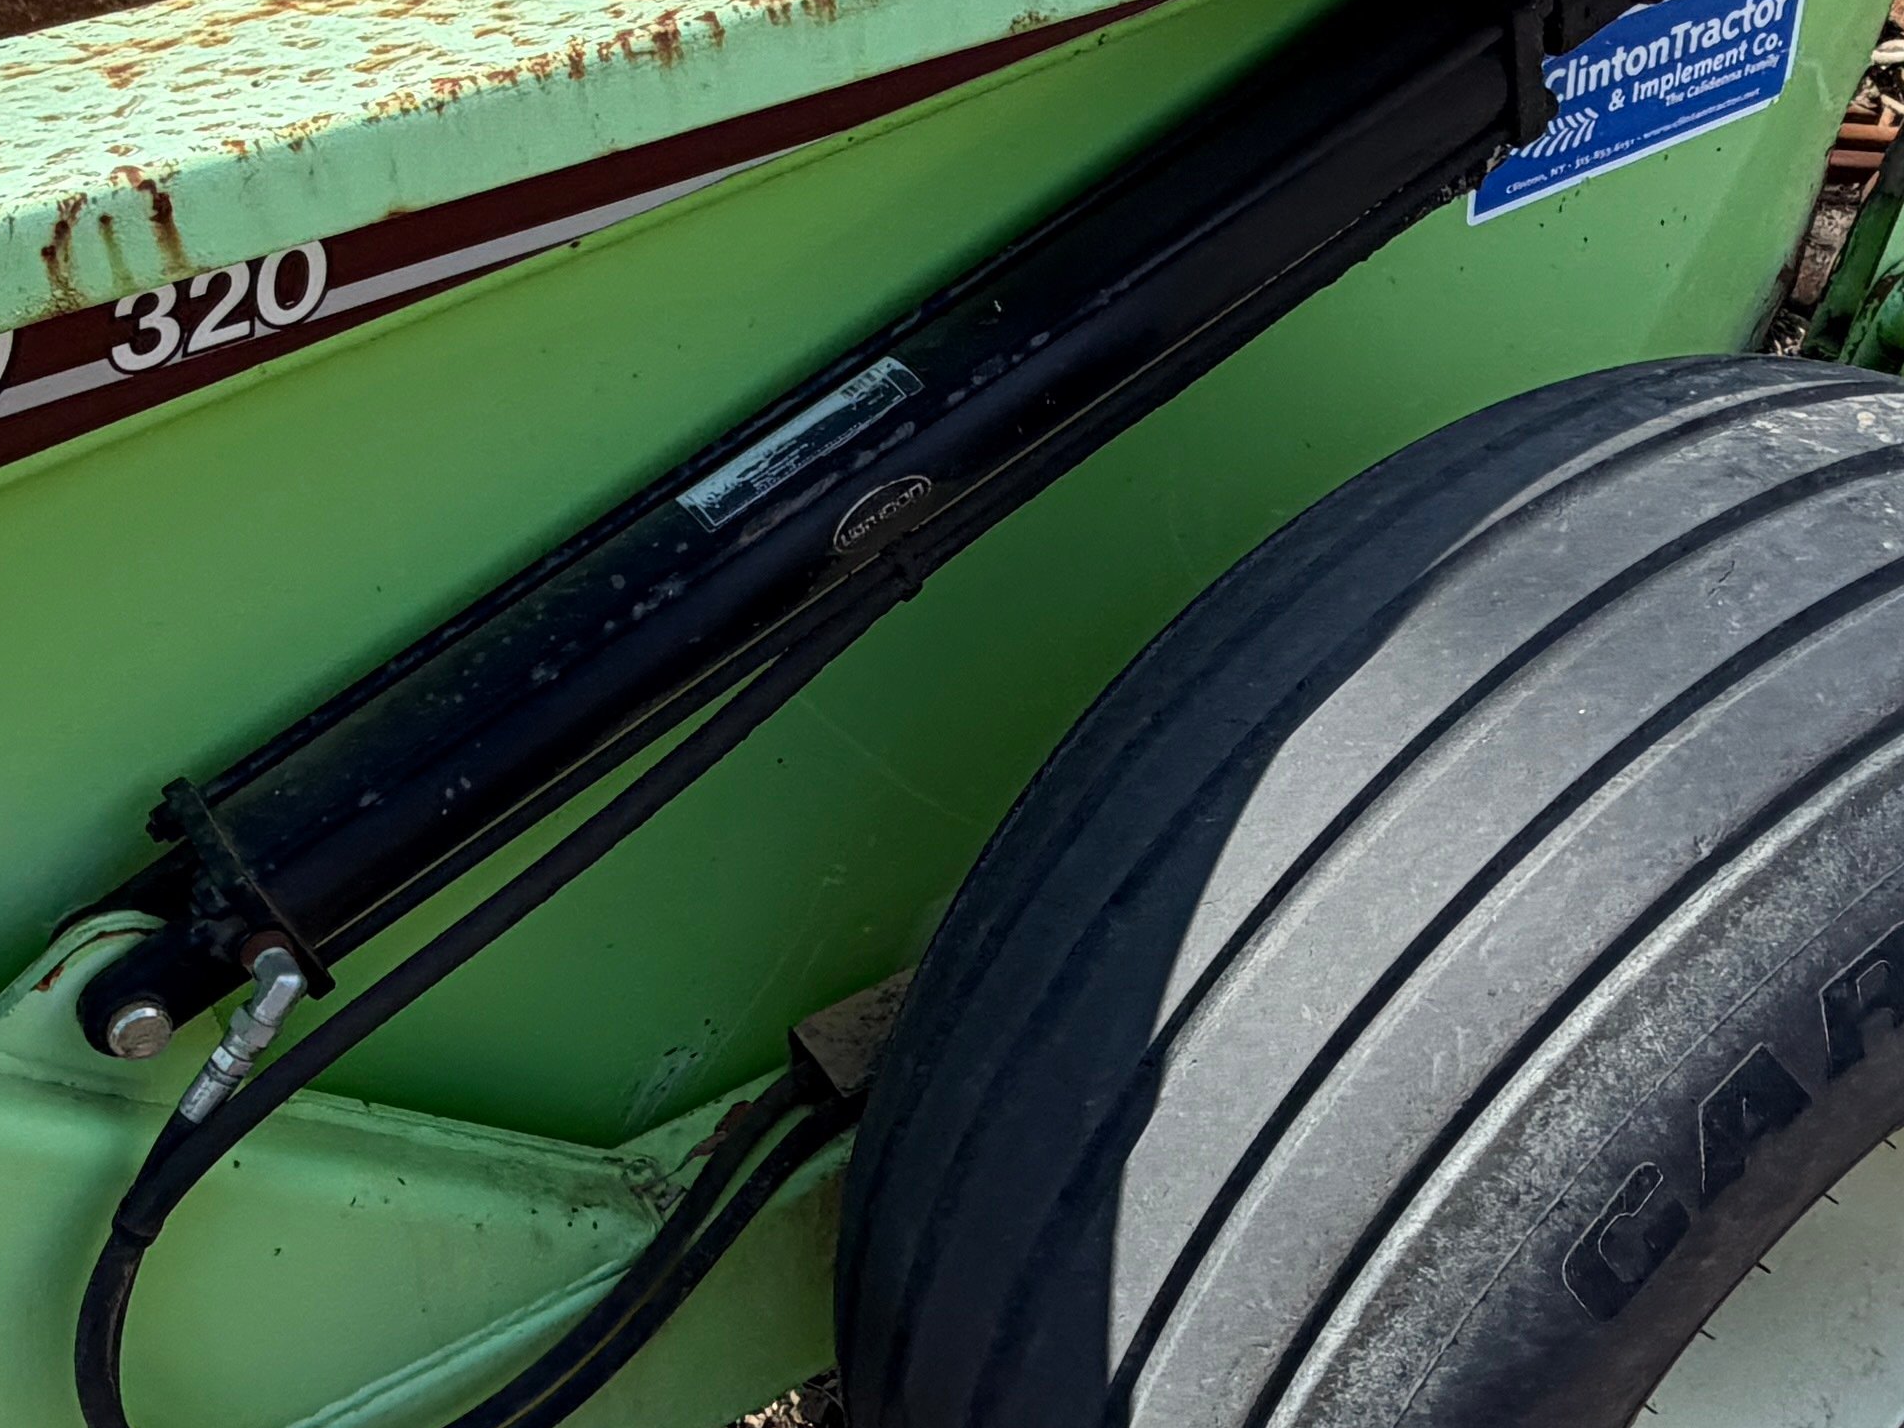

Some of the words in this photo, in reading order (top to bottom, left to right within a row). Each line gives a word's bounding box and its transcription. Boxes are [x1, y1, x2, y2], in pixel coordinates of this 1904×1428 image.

[1608, 88, 1626, 112] &
[1631, 38, 1749, 104] Implement
[1752, 32, 1784, 56] Co.
[1665, 91, 1685, 107] The
[110, 238, 329, 373] 320
